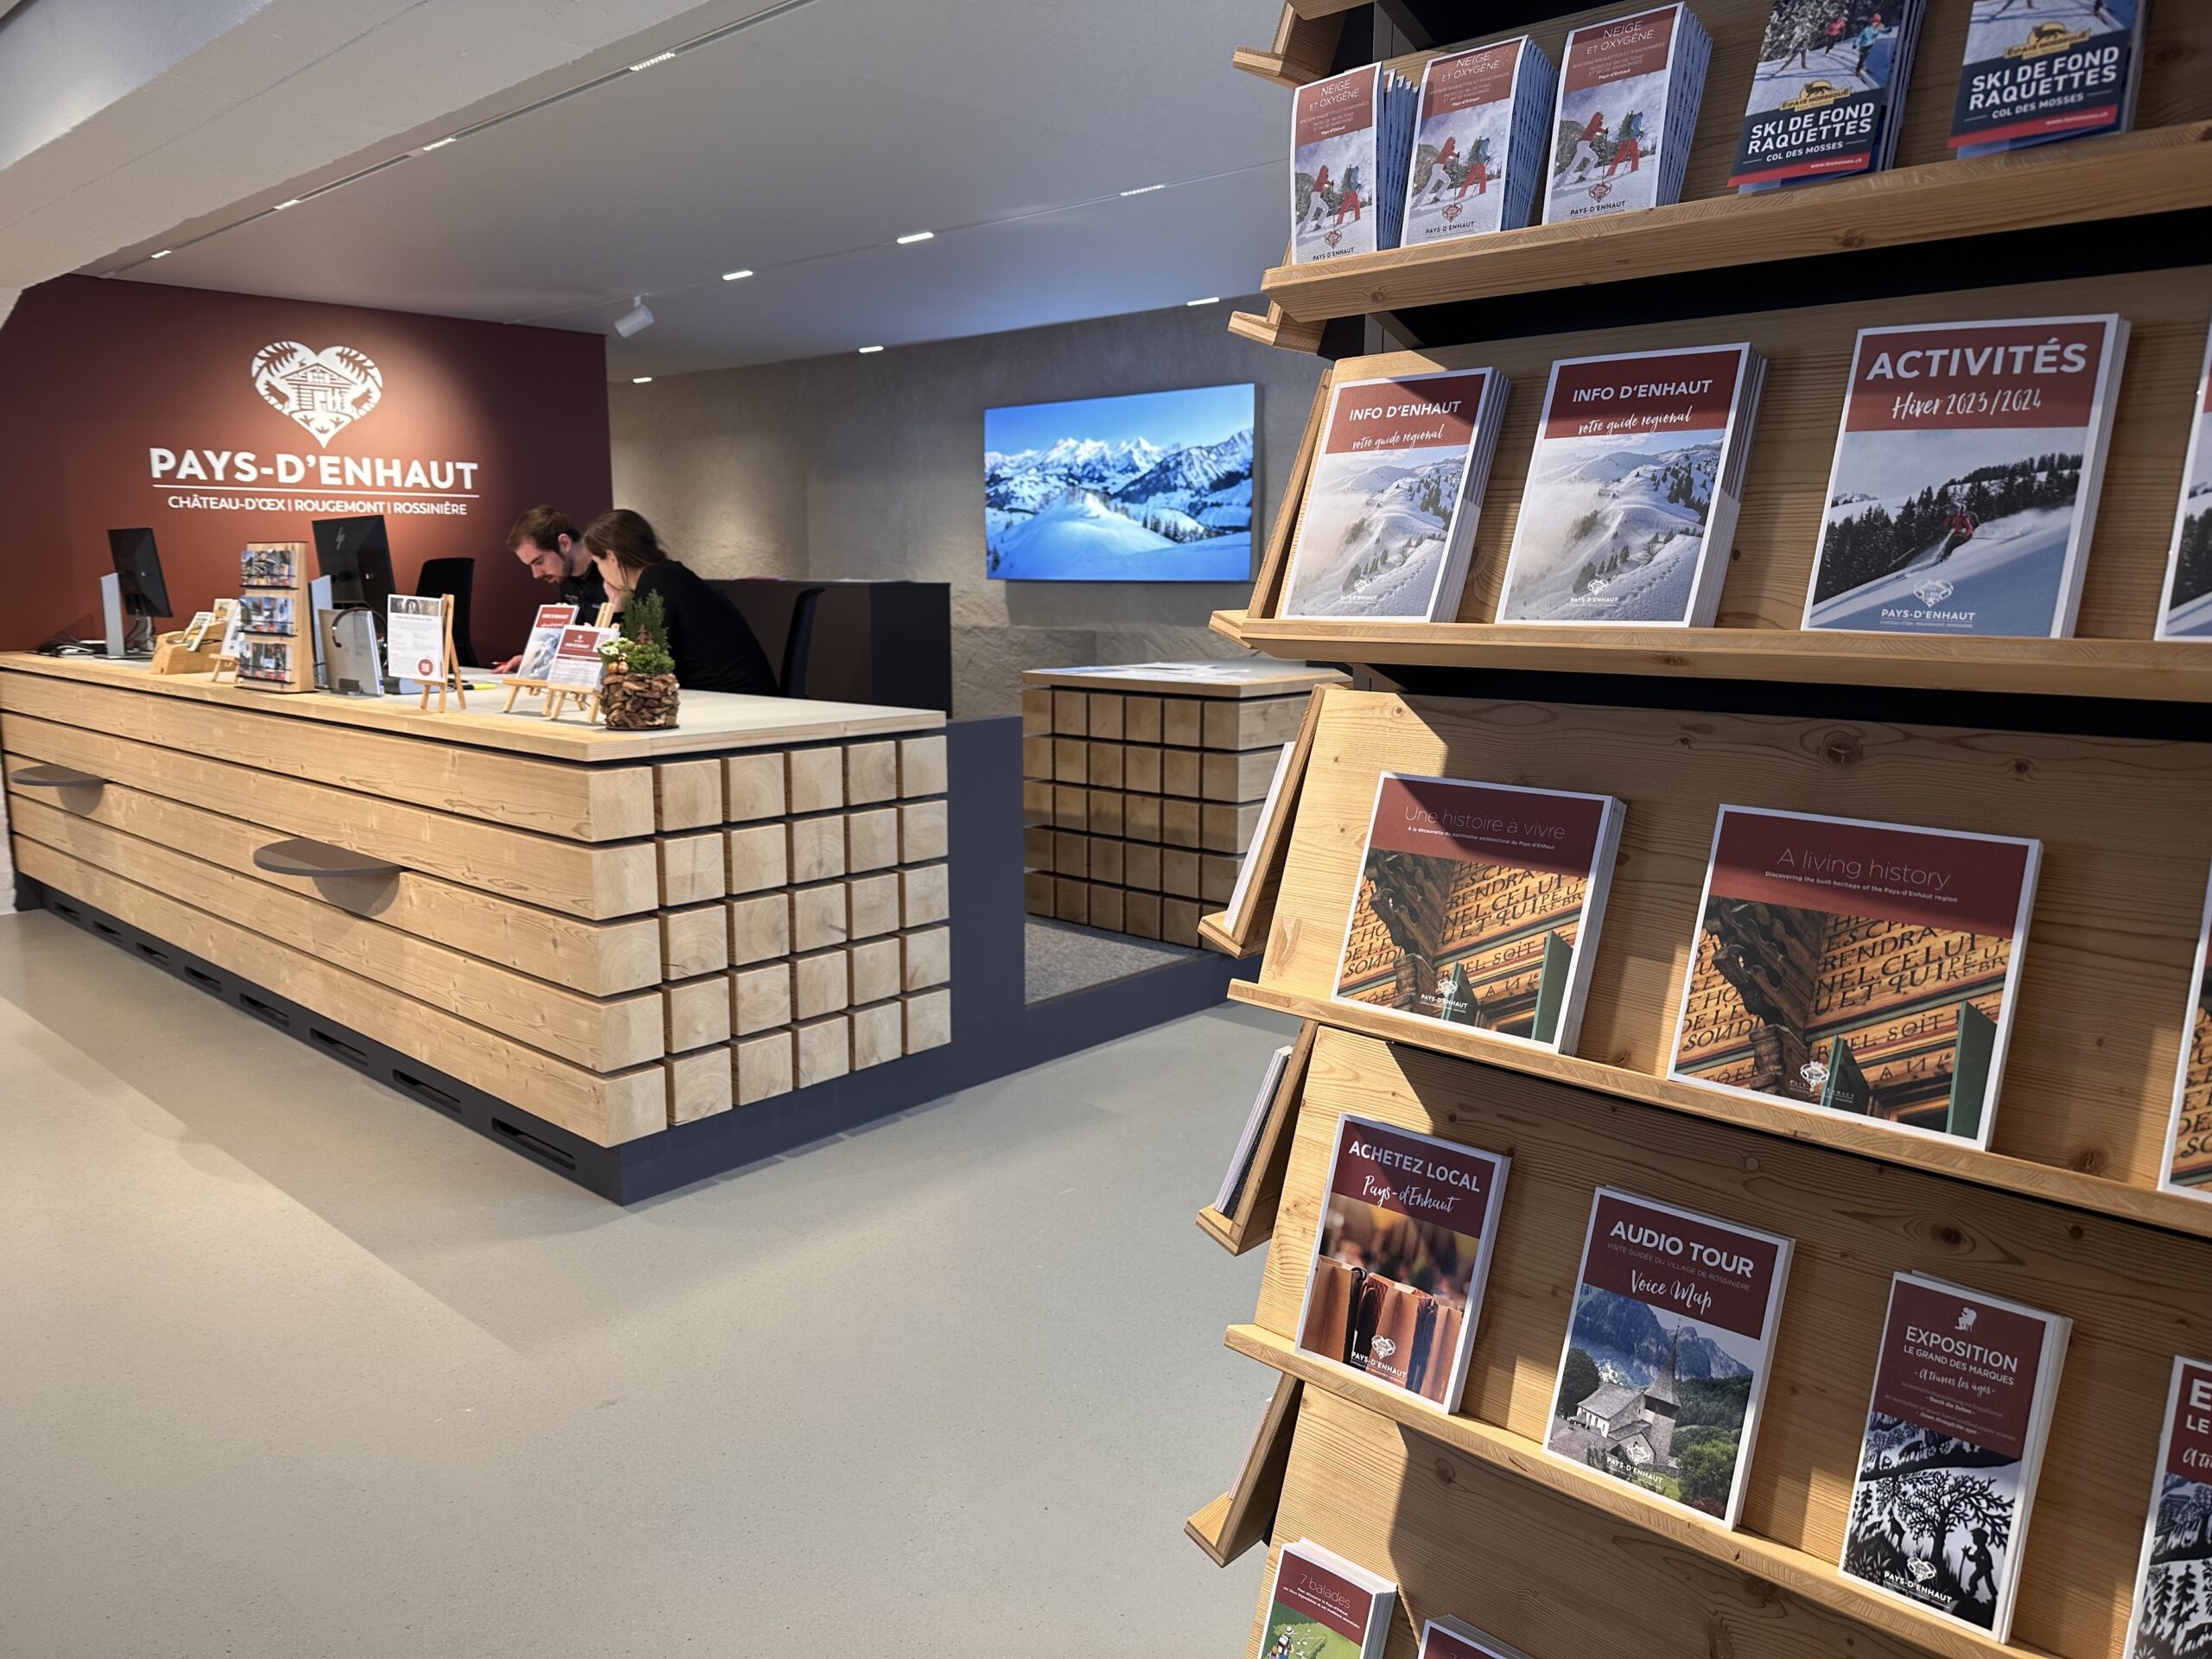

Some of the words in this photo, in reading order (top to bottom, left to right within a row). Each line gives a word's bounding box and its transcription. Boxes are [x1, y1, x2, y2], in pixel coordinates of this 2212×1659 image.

[1586, 45, 1598, 54] ET
[1600, 29, 1655, 50] OXYGÈNE
[1603, 20, 1643, 40] NEIGE
[1441, 73, 1451, 82] ET
[1453, 60, 1500, 79] OXYGÈNE
[1456, 52, 1491, 67] NEIGE
[1971, 69, 2010, 92] SKI
[2017, 60, 2048, 83] DE
[2052, 46, 2120, 75] FOND
[1309, 102, 1318, 111] ET
[1319, 88, 1359, 107] OXYGÈNE
[1320, 79, 1351, 96] NEIGE
[1969, 65, 2117, 111] RAQUETTES
[1751, 119, 1783, 139] SKI
[1788, 113, 1815, 132] DE
[1818, 102, 1874, 125] FOND
[1992, 108, 2012, 119] COL
[2015, 102, 2037, 114] DES
[2038, 92, 2084, 109] MOSSES
[1747, 118, 1872, 155] RAQUETTES
[1766, 153, 1783, 162] COL
[1786, 148, 1803, 158] DES
[1805, 141, 1844, 154] MOSSES
[1866, 336, 2088, 381] ACTIVITÉS
[1573, 387, 1614, 403] INFO
[1619, 379, 1713, 399] D'ENHAUT
[1891, 391, 1943, 420] Hiver
[1349, 407, 1382, 421] INFO
[1386, 401, 1461, 418] D'ENHAUT
[1606, 413, 1638, 435] guide
[1375, 430, 1400, 451] guide
[149, 447, 479, 491] PAYS-D'ENHAUT
[295, 500, 385, 515] ROUGEMONT
[393, 500, 467, 516] ROSSINIÈRE
[1881, 608, 1975, 620] PAYS-D'ENHAUT
[1405, 804, 1438, 823] Une
[1443, 809, 1503, 832] histoire
[1507, 818, 1518, 834] à
[1523, 821, 1566, 840] vivre
[1777, 848, 1795, 867] A
[1802, 850, 1862, 880] living
[1869, 858, 1951, 890] history
[1765, 871, 1802, 882] Discovering
[1833, 880, 1860, 891] heritage
[1935, 894, 1958, 904] region
[1348, 1141, 1424, 1175] ACHETEZ
[1427, 1162, 1480, 1192] LOCAL
[1610, 1220, 1683, 1255] AUDIO
[1689, 1242, 1754, 1279] TOUR
[1606, 1242, 1627, 1254] VISITE
[1628, 1248, 1653, 1262] GUIDÉE
[1655, 1256, 1666, 1265] DU
[1666, 1259, 1695, 1274] VILLAGE
[1697, 1269, 1707, 1278] DE
[1708, 1272, 1751, 1292] ROSSINIÈRE
[1631, 1268, 1667, 1295] Voice
[1670, 1280, 1713, 1315] Map
[1351, 1351, 1408, 1378] PAYS-D'ENHAUT
[1905, 1325, 2018, 1373] EXPOSITION
[1904, 1344, 1916, 1355] LE
[1916, 1348, 1948, 1364] GRAND
[1949, 1358, 1967, 1371] DES
[1968, 1364, 2014, 1386] MARQUES
[2186, 1414, 2210, 1434] LE
[1300, 1573, 1308, 1585] 7
[1308, 1577, 1351, 1609] balades
[1884, 1570, 1952, 1603] PAYS-D'ENHAUT
